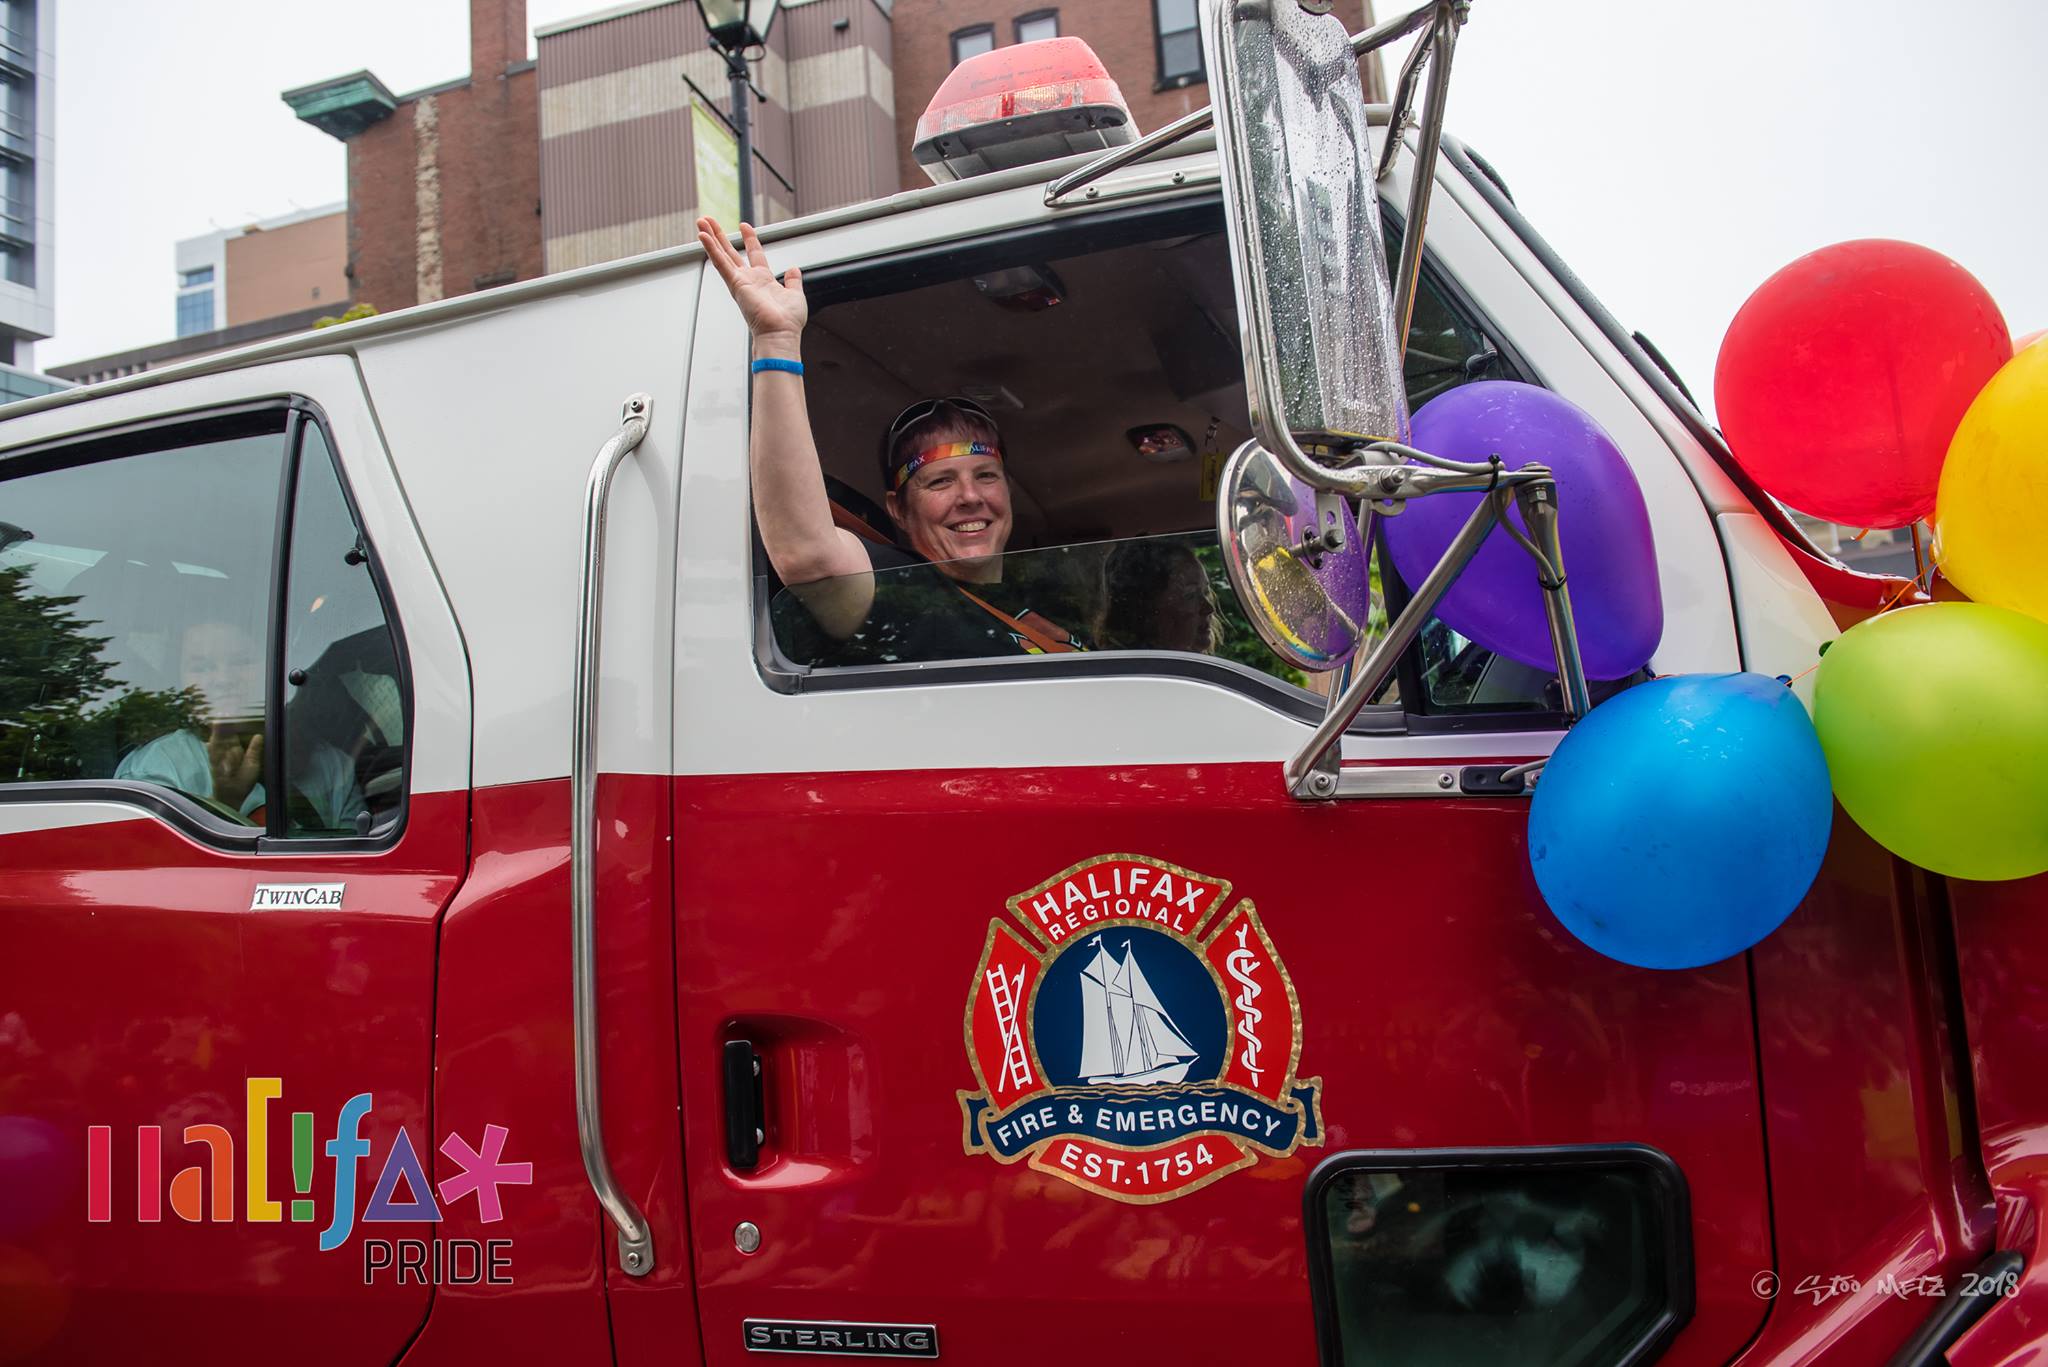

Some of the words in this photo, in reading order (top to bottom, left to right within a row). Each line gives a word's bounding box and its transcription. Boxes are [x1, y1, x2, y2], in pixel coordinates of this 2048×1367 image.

[1032, 868, 1205, 924] HALIFAX
[1048, 899, 1184, 941] REGIONAL
[997, 1106, 1057, 1147] FIRE
[1067, 1104, 1084, 1124] &
[1095, 1101, 1281, 1137] EMERGENCY
[750, 1326, 929, 1350] STERLING
